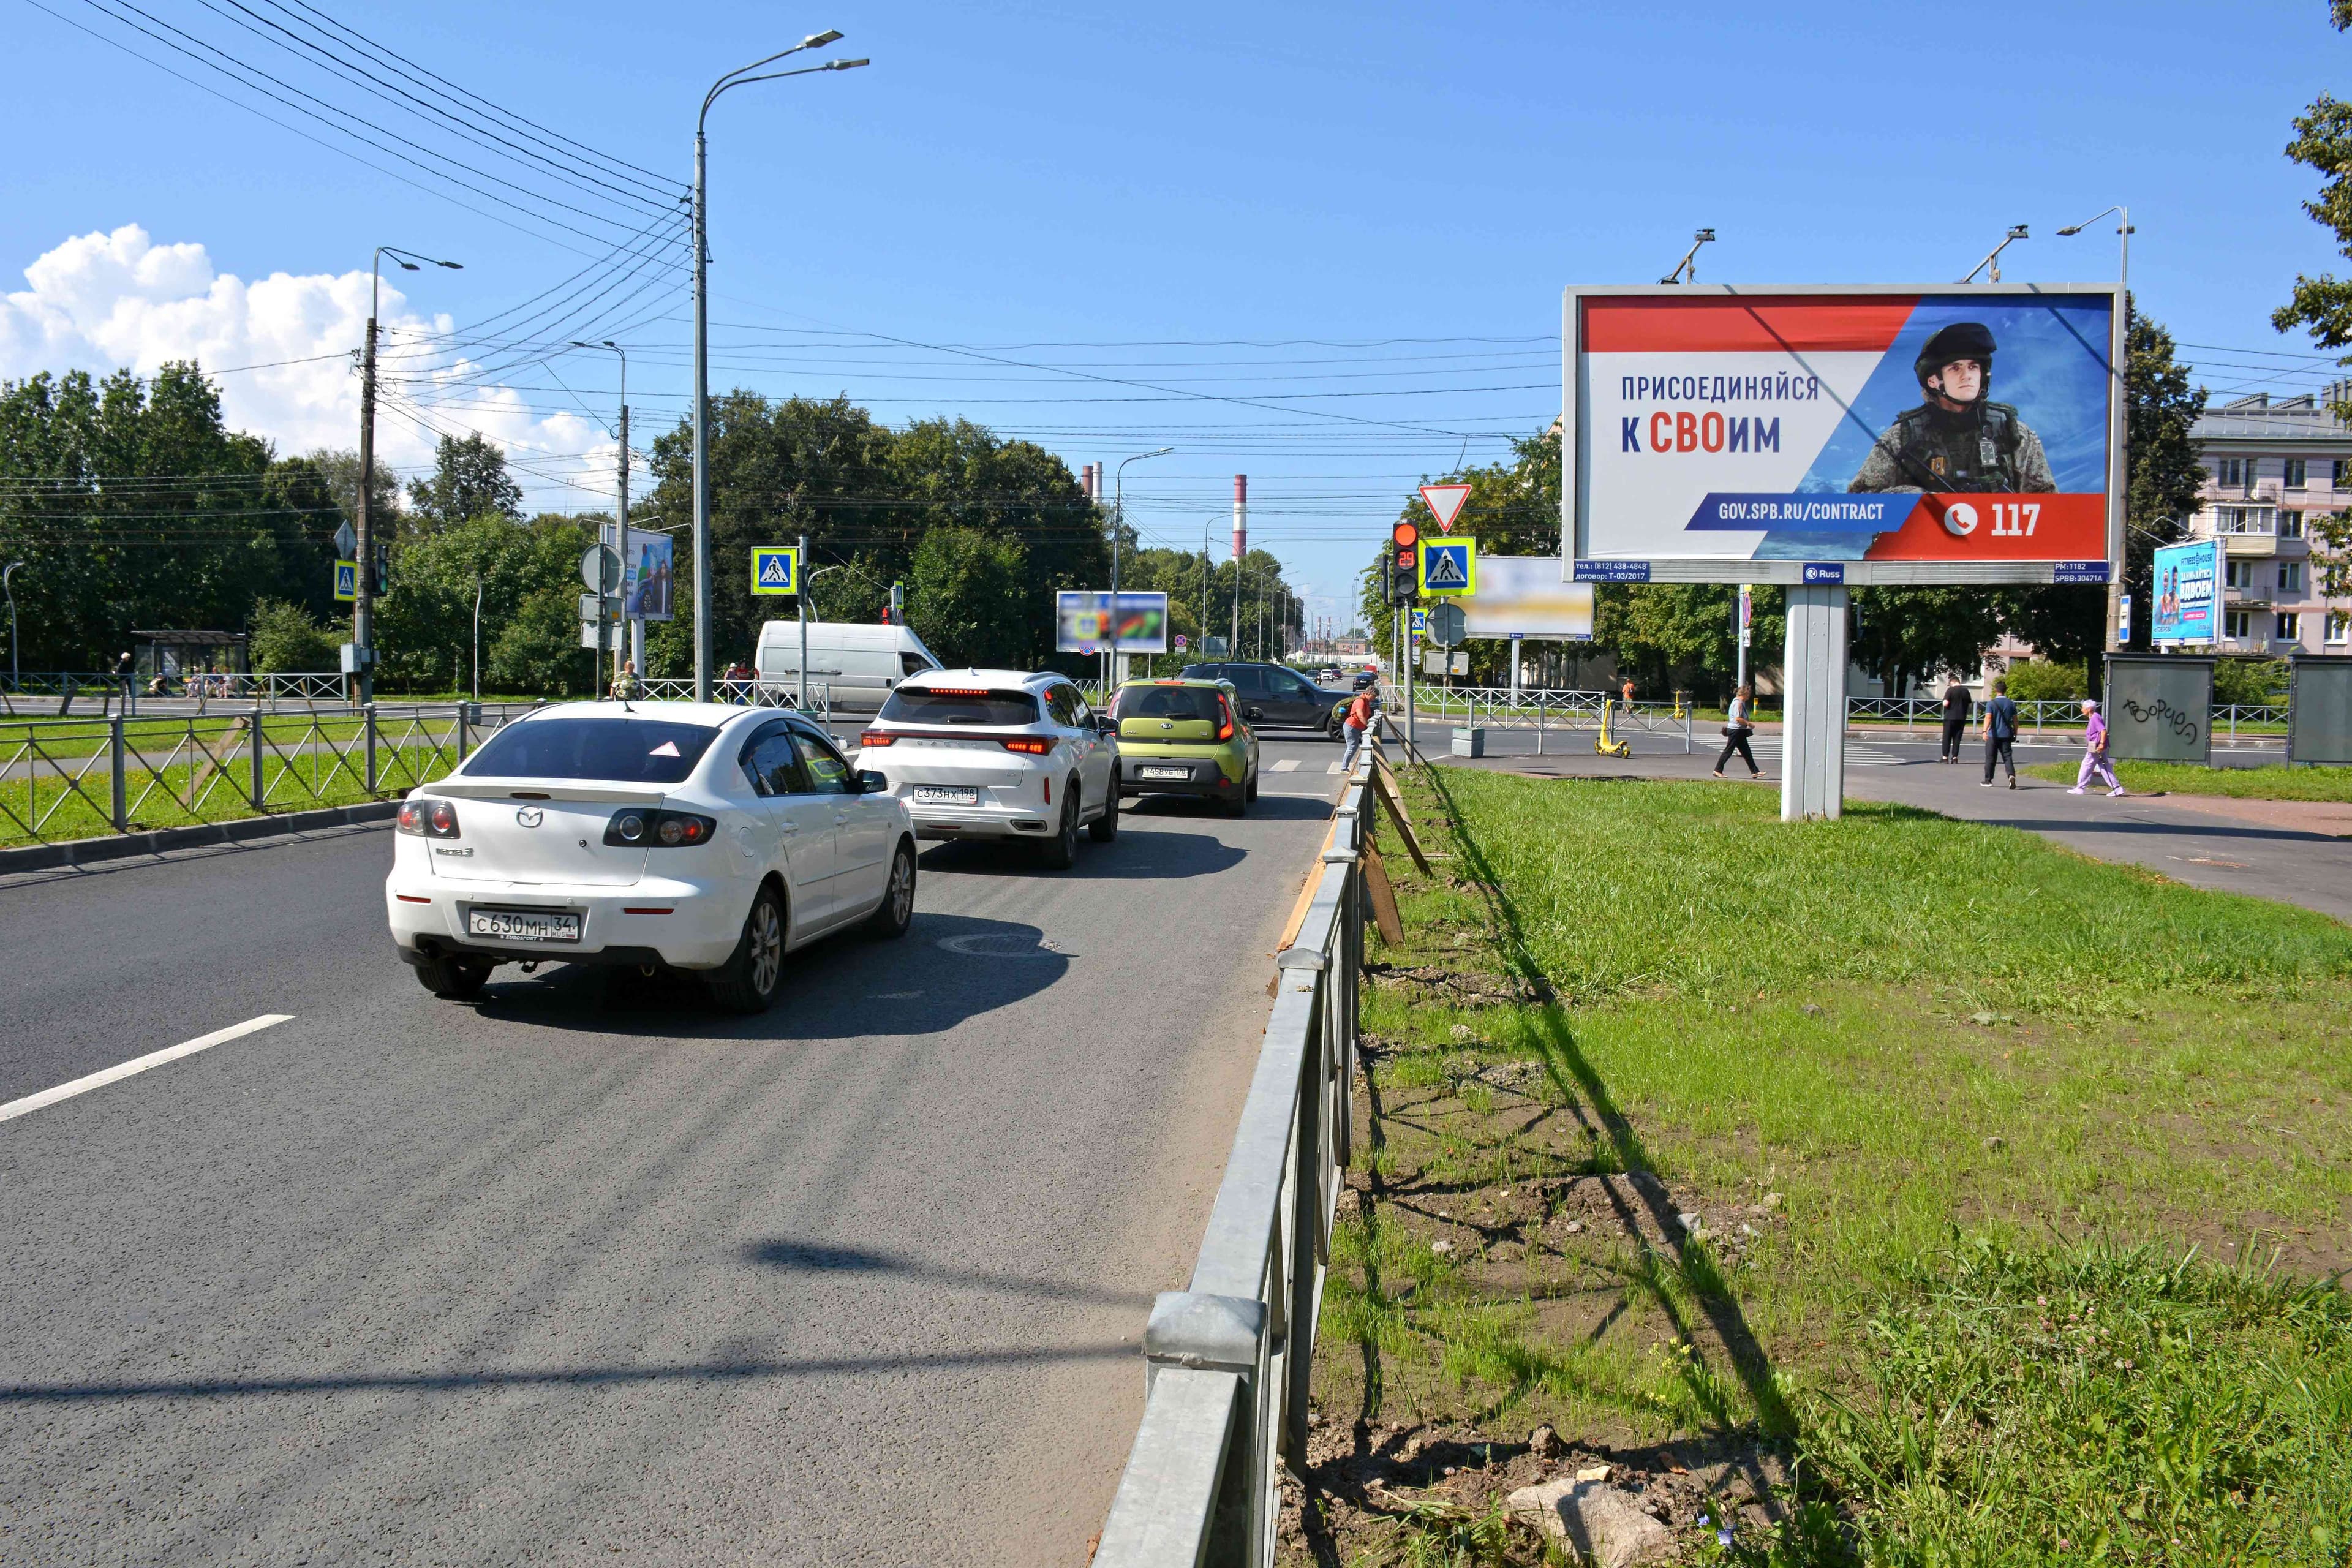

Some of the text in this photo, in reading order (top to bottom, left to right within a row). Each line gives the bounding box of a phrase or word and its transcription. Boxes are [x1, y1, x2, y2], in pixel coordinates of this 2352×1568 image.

[1622, 371, 1819, 403] ПРИСОЕДИНЯЙСЯ
[1622, 411, 1780, 453] К СВОИМ
[1719, 502, 1885, 521] GOV.SPB.RU/CONTRACT
[1991, 503, 2041, 536] 117
[1399, 552, 1414, 566] 29
[2199, 553, 2212, 563] HOUSE
[2180, 580, 2212, 601] ВДВОЕМ
[917, 787, 974, 799] С373НХ 198
[477, 914, 571, 935] С630МН 34
